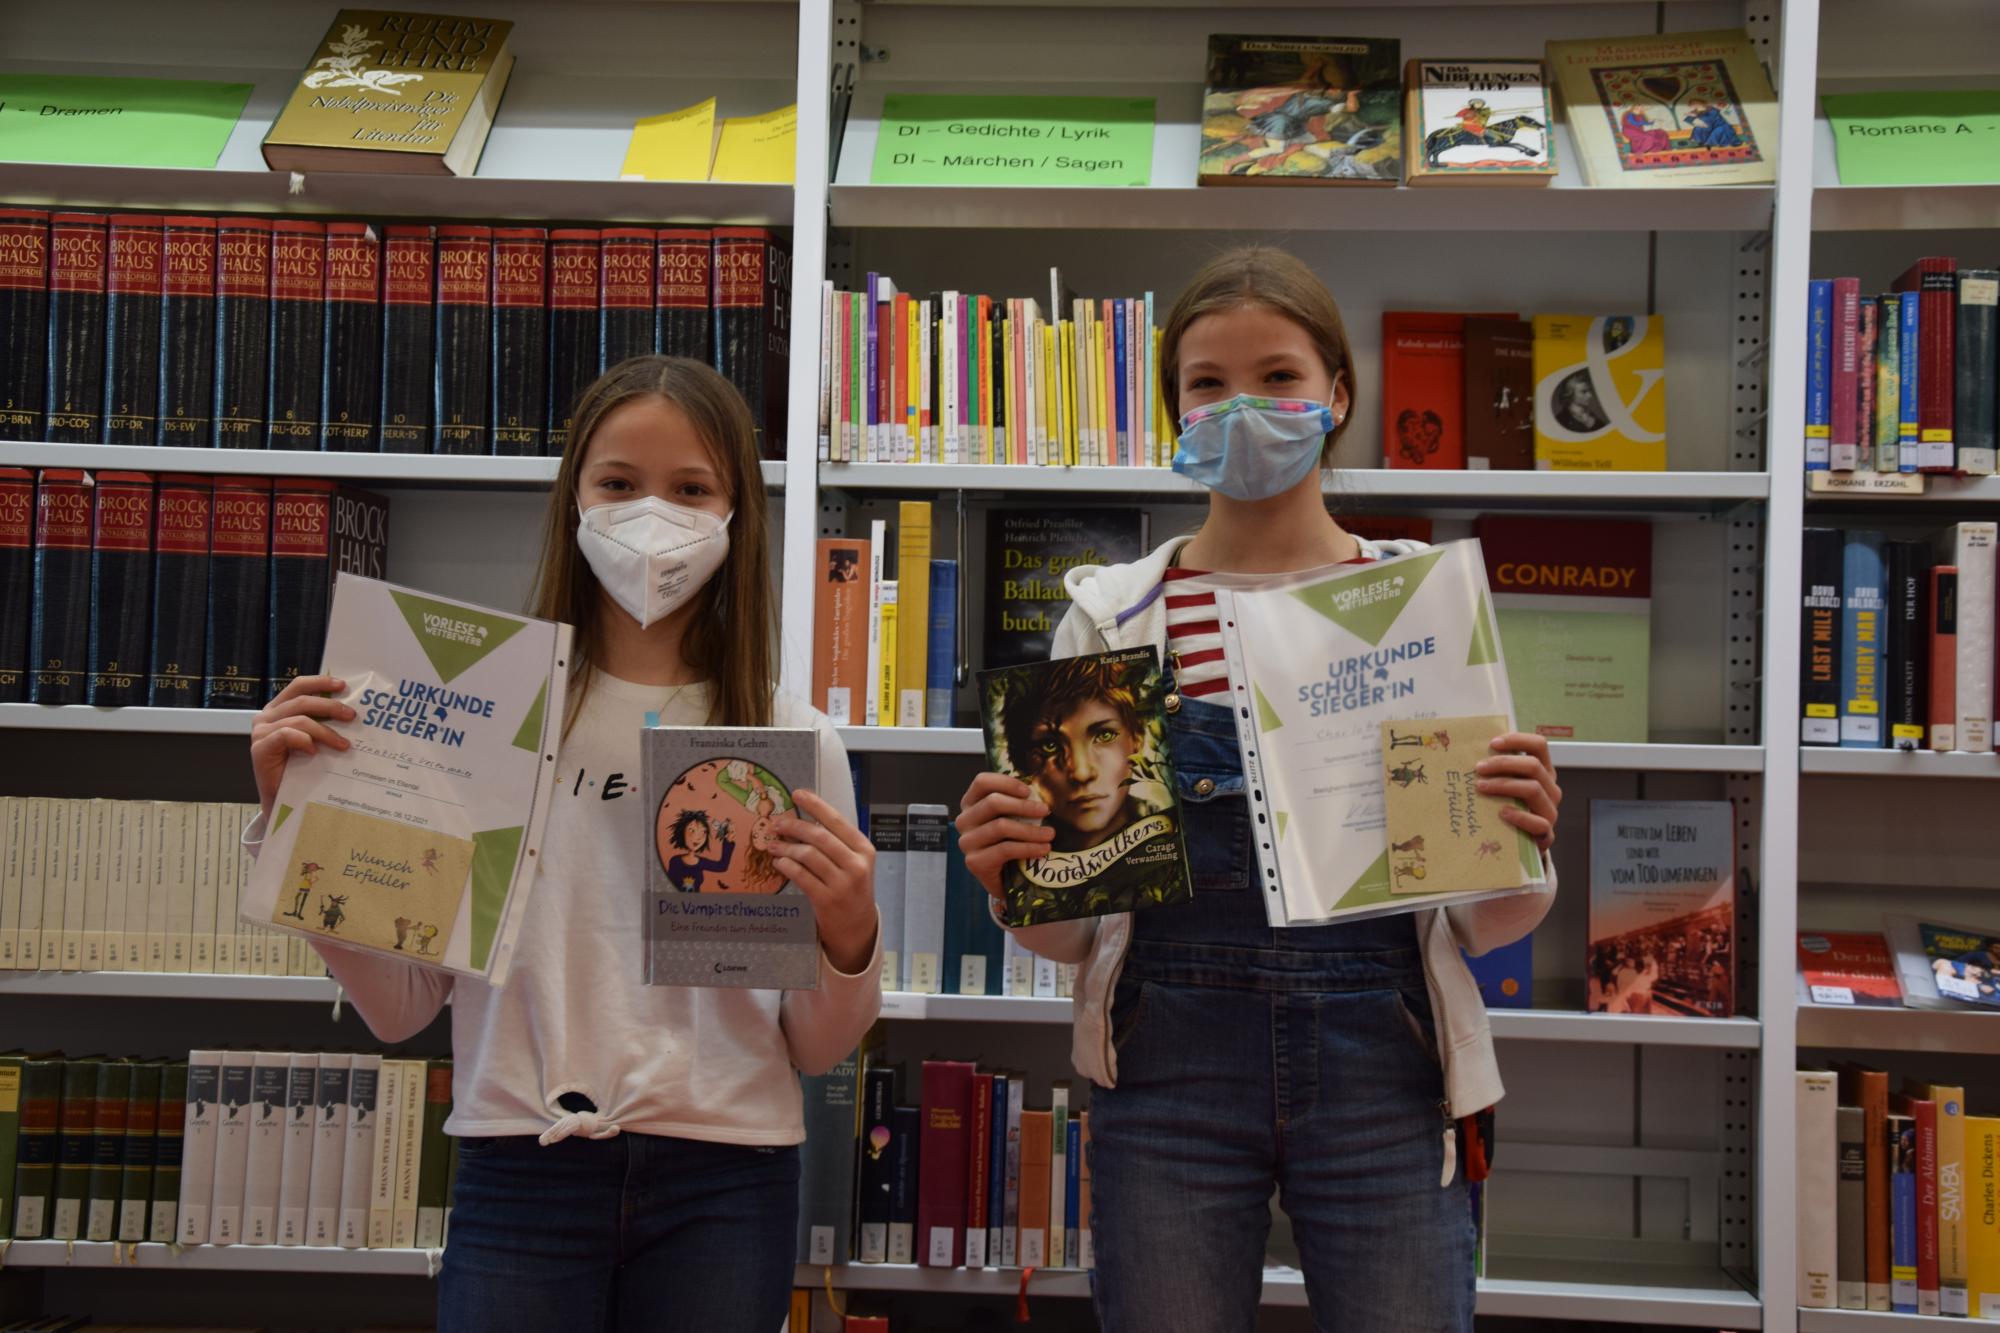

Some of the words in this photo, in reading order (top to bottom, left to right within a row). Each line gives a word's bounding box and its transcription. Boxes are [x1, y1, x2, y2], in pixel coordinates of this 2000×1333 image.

[379, 16, 495, 38] RUHM
[397, 34, 489, 54] UND
[374, 52, 481, 73] EHRE
[1425, 66, 1540, 82] NIBELUNGEN
[425, 89, 460, 104] Die
[39, 105, 123, 117] Dramen
[410, 116, 446, 134] für
[947, 122, 1040, 139] Gedichte
[1061, 126, 1112, 142] Lyrik
[1849, 124, 1946, 137] Romane
[1955, 123, 1972, 134] A
[942, 153, 1034, 169] Märchen
[1055, 156, 1124, 172] Sagen
[53, 238, 103, 253] BROCK
[110, 239, 158, 255] BROCK
[165, 242, 212, 256] BROCK
[219, 242, 267, 257] BROCK
[273, 246, 322, 260] BROCK
[57, 253, 97, 268] HAUS
[114, 255, 154, 269] HAUS
[327, 248, 376, 263] BROCK
[440, 250, 488, 265] BROCK
[495, 252, 541, 267] BROCK
[552, 254, 597, 270] BROCK
[604, 254, 650, 269] BROCK
[659, 253, 707, 268] BROCK
[714, 253, 760, 267] BROCK
[168, 257, 208, 272] HAUS
[223, 258, 262, 273] HAUS
[277, 261, 317, 276] HAUS
[332, 263, 371, 277] HAUS
[388, 265, 426, 280] HAUS
[444, 265, 483, 280] HAUS
[499, 267, 538, 282] HAUS
[555, 270, 593, 284] HAUS
[608, 269, 647, 283] HAUS
[664, 269, 703, 283] HAUS
[719, 268, 757, 282] HAUS
[394, 414, 405, 424] 10
[453, 414, 461, 424] 11
[508, 416, 517, 426] 12
[1827, 479, 1866, 488] ROMANE
[41, 493, 89, 509] BROCK
[99, 496, 148, 513] BROCK
[160, 498, 208, 514] BROCK
[216, 500, 265, 517] BROCK
[45, 508, 85, 524] HAUS
[276, 503, 325, 517] BROCK
[103, 511, 143, 526] HAUS
[163, 514, 203, 528] HAUS
[220, 516, 262, 530] HAUS
[280, 517, 321, 532] HAUS
[336, 496, 388, 547] BROCK
[1005, 518, 1040, 528] Otfried
[1043, 518, 1084, 529] Preußler
[1005, 532, 1047, 543] Heinrich
[1003, 549, 1042, 569] Das
[1496, 563, 1637, 589] CONRADY
[1332, 579, 1391, 604] VORLESE
[1906, 576, 1915, 597] HOF
[1336, 589, 1401, 613] WETTBEWERB
[1906, 600, 1915, 620] DER
[423, 612, 477, 637] VORLESE
[1002, 609, 1050, 632] buch
[1813, 610, 1832, 641] MILE
[1856, 611, 1875, 641] MAN
[424, 626, 484, 647] WETTBEWERB
[1099, 654, 1120, 666] Katja
[1121, 651, 1150, 663] Brandis
[1328, 636, 1436, 679] URKUNDE
[1813, 645, 1832, 681] LAST
[107, 661, 119, 671] 21
[167, 663, 179, 674] 22
[225, 665, 238, 676] 23
[285, 667, 298, 678] 24
[1298, 675, 1369, 703] SCHUL
[360, 688, 429, 722] SCHUL
[398, 679, 496, 719] URKUNDE
[690, 738, 735, 748] Franziska
[738, 737, 768, 748] Gehm
[1444, 769, 1463, 838] Erfüller
[1617, 825, 1648, 840] MITTEN
[1665, 822, 1697, 843] LEBEN
[1024, 815, 1170, 884] Woodwalkers
[1145, 841, 1176, 853] Carags
[350, 848, 415, 875] Wunsch
[1125, 851, 1179, 866] Verwandlung
[342, 864, 411, 891] Erfüller
[1610, 868, 1635, 884] VOM
[1637, 863, 1659, 883] TOD
[1660, 866, 1718, 883] UMFANGEN
[659, 900, 680, 915] Die
[681, 902, 800, 918] Vampirschwestern
[1922, 1128, 1935, 1180] Alchimist
[1981, 1133, 1994, 1178] Dickens
[1923, 1184, 1935, 1206] Der
[1940, 1162, 1960, 1221] SAMBA
[1981, 1183, 1994, 1226] Charles
